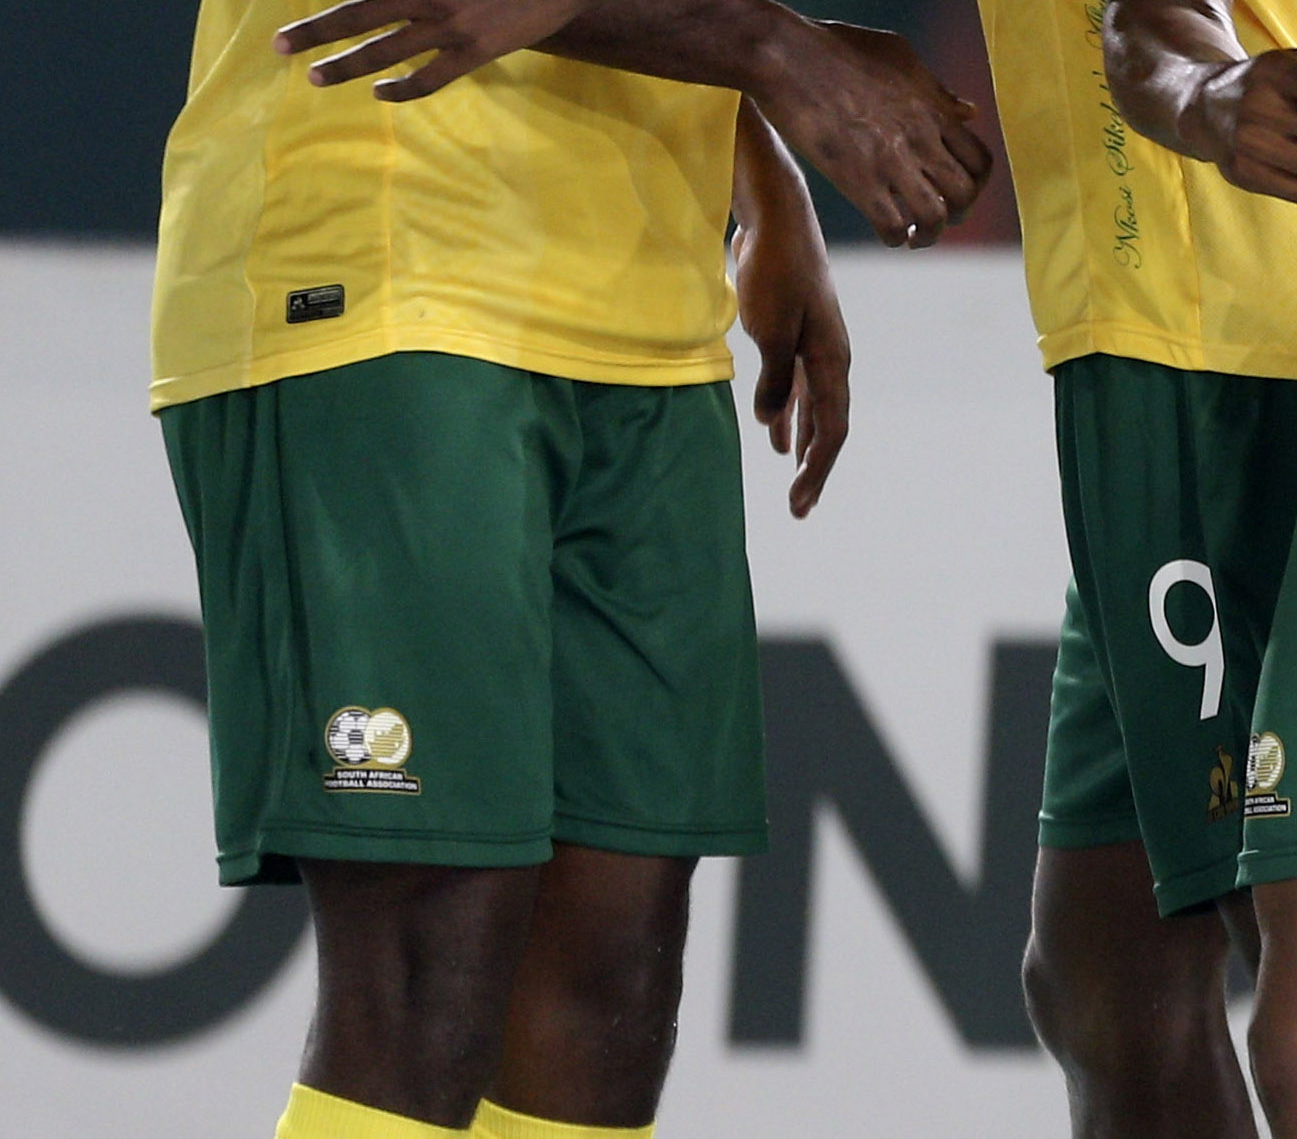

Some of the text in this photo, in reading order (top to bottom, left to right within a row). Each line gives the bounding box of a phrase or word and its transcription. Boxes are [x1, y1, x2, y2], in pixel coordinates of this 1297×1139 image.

[1148, 559, 1225, 721] 9
[336, 770, 404, 780] SOUTH AFRICAN
[366, 781, 418, 791] ASSOCIATION
